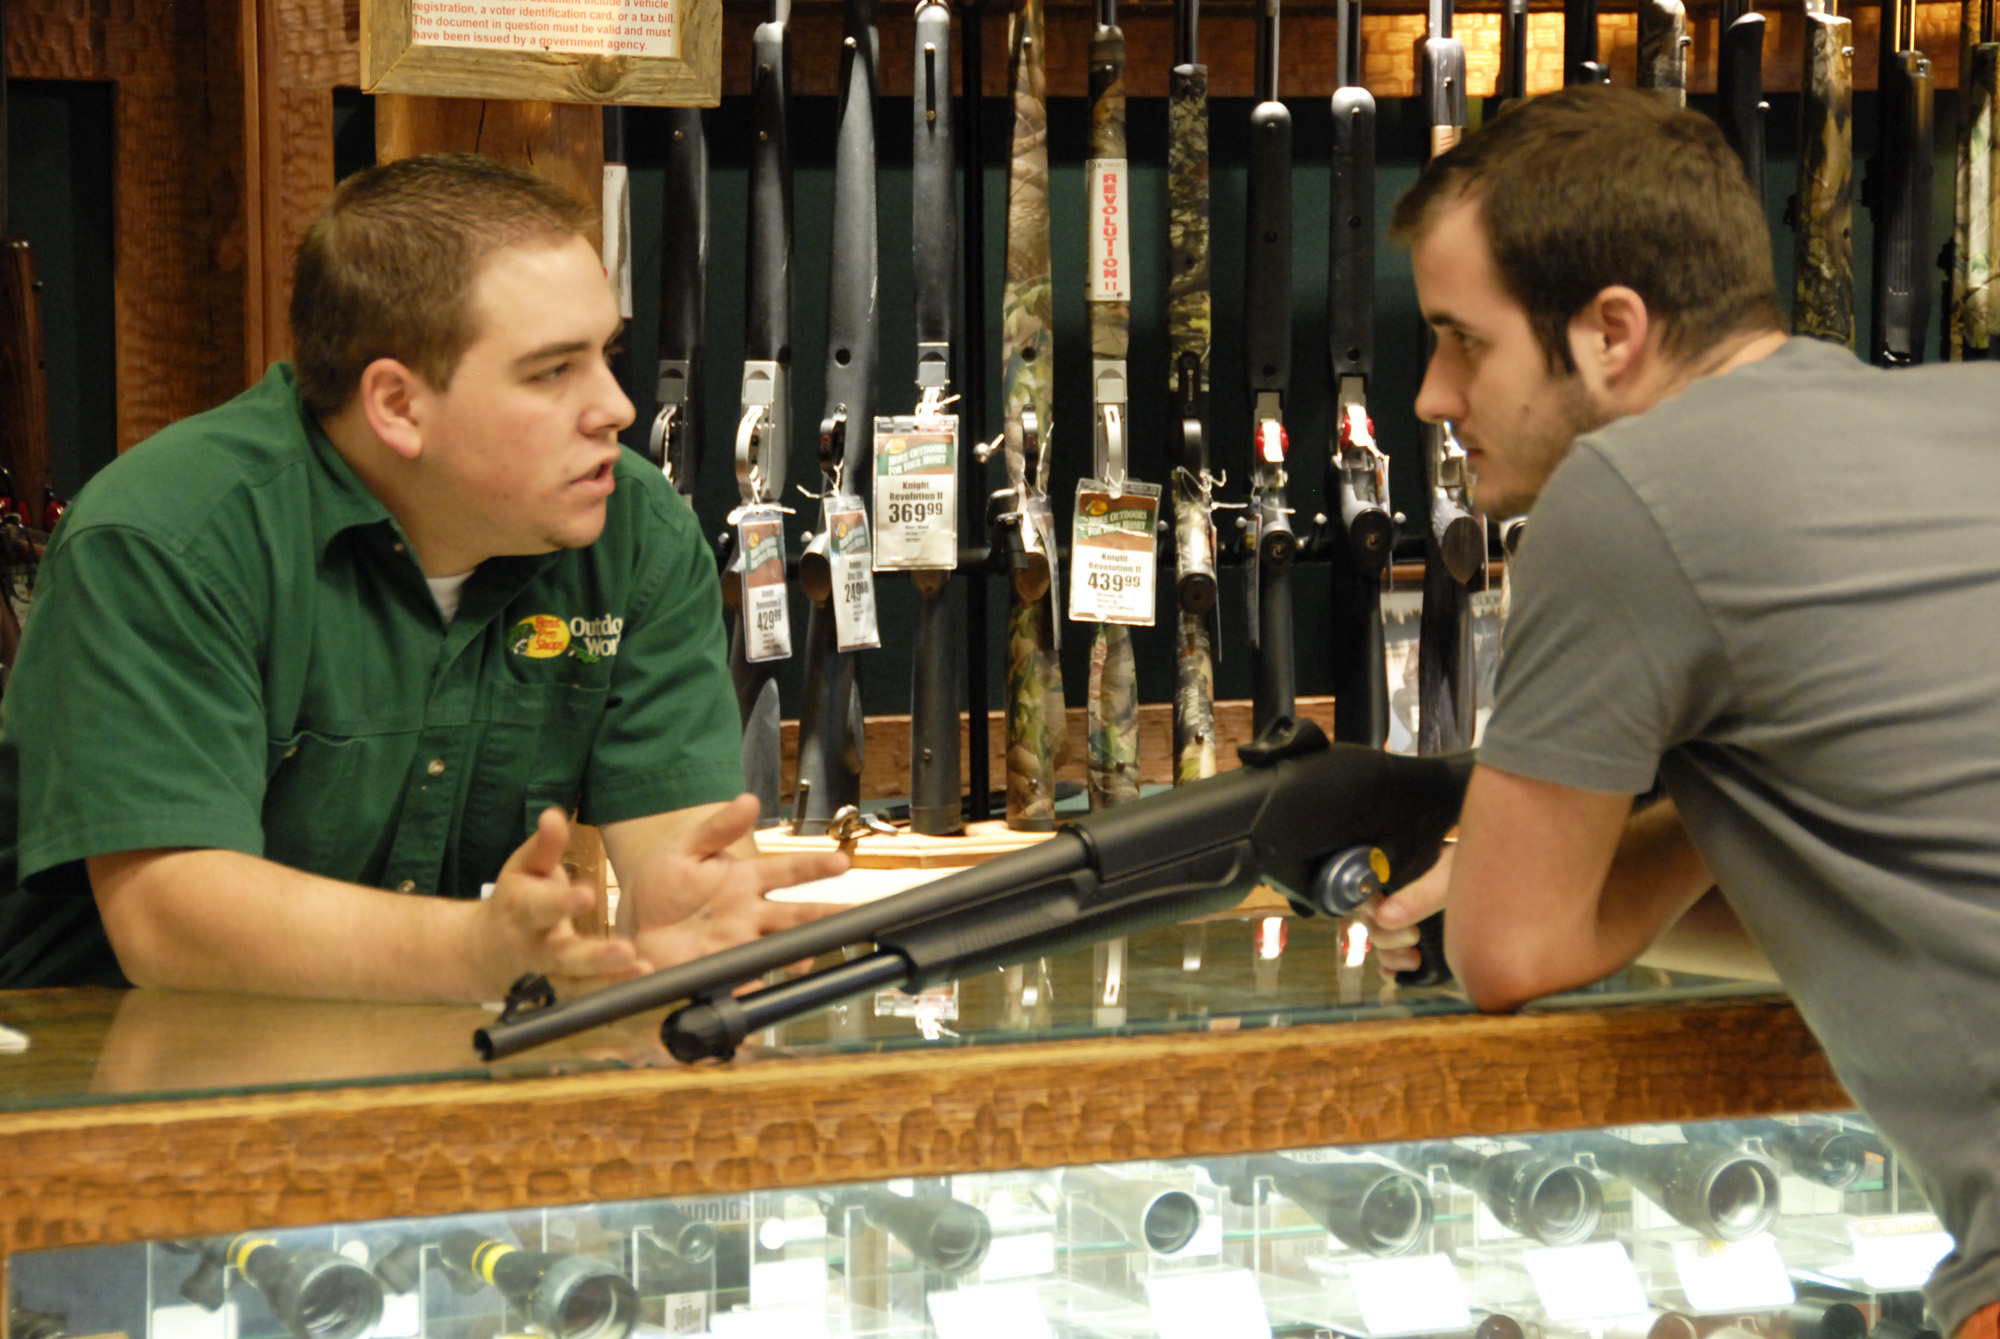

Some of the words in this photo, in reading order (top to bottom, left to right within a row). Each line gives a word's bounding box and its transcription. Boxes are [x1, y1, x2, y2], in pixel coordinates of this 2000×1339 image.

[633, 0, 669, 8] vehicle
[412, 1, 477, 14] registration,
[480, 6, 486, 14] a
[490, 6, 516, 15] voter
[519, 6, 586, 19] identification
[589, 10, 615, 21] card,
[618, 13, 628, 21] or
[640, 13, 655, 22] tax
[658, 13, 676, 24] bill.
[412, 14, 432, 25] The
[436, 16, 489, 28] document
[492, 18, 501, 29] in
[505, 20, 549, 32] question
[553, 23, 578, 33] must
[582, 23, 594, 33] be
[597, 24, 621, 34] valid
[624, 26, 643, 36] and
[646, 28, 671, 37] must
[412, 29, 439, 40] have
[443, 30, 470, 41] been
[474, 32, 510, 43] issued
[513, 34, 526, 46] by
[530, 37, 536, 45] a
[539, 37, 604, 48] government
[607, 40, 647, 52] agency.
[1102, 173, 1118, 278] REVOLUTION
[1105, 282, 1117, 291] II
[902, 481, 929, 490] Knight
[889, 492, 935, 501] Revolution
[937, 492, 943, 500] II
[1109, 510, 1147, 522] OUTDOORS
[1122, 520, 1147, 530] MONEY
[1101, 553, 1128, 562] Knight
[1088, 562, 1133, 573] Revolution
[535, 616, 561, 628] Bass
[538, 628, 557, 638] Pro
[534, 639, 565, 653] Shops
